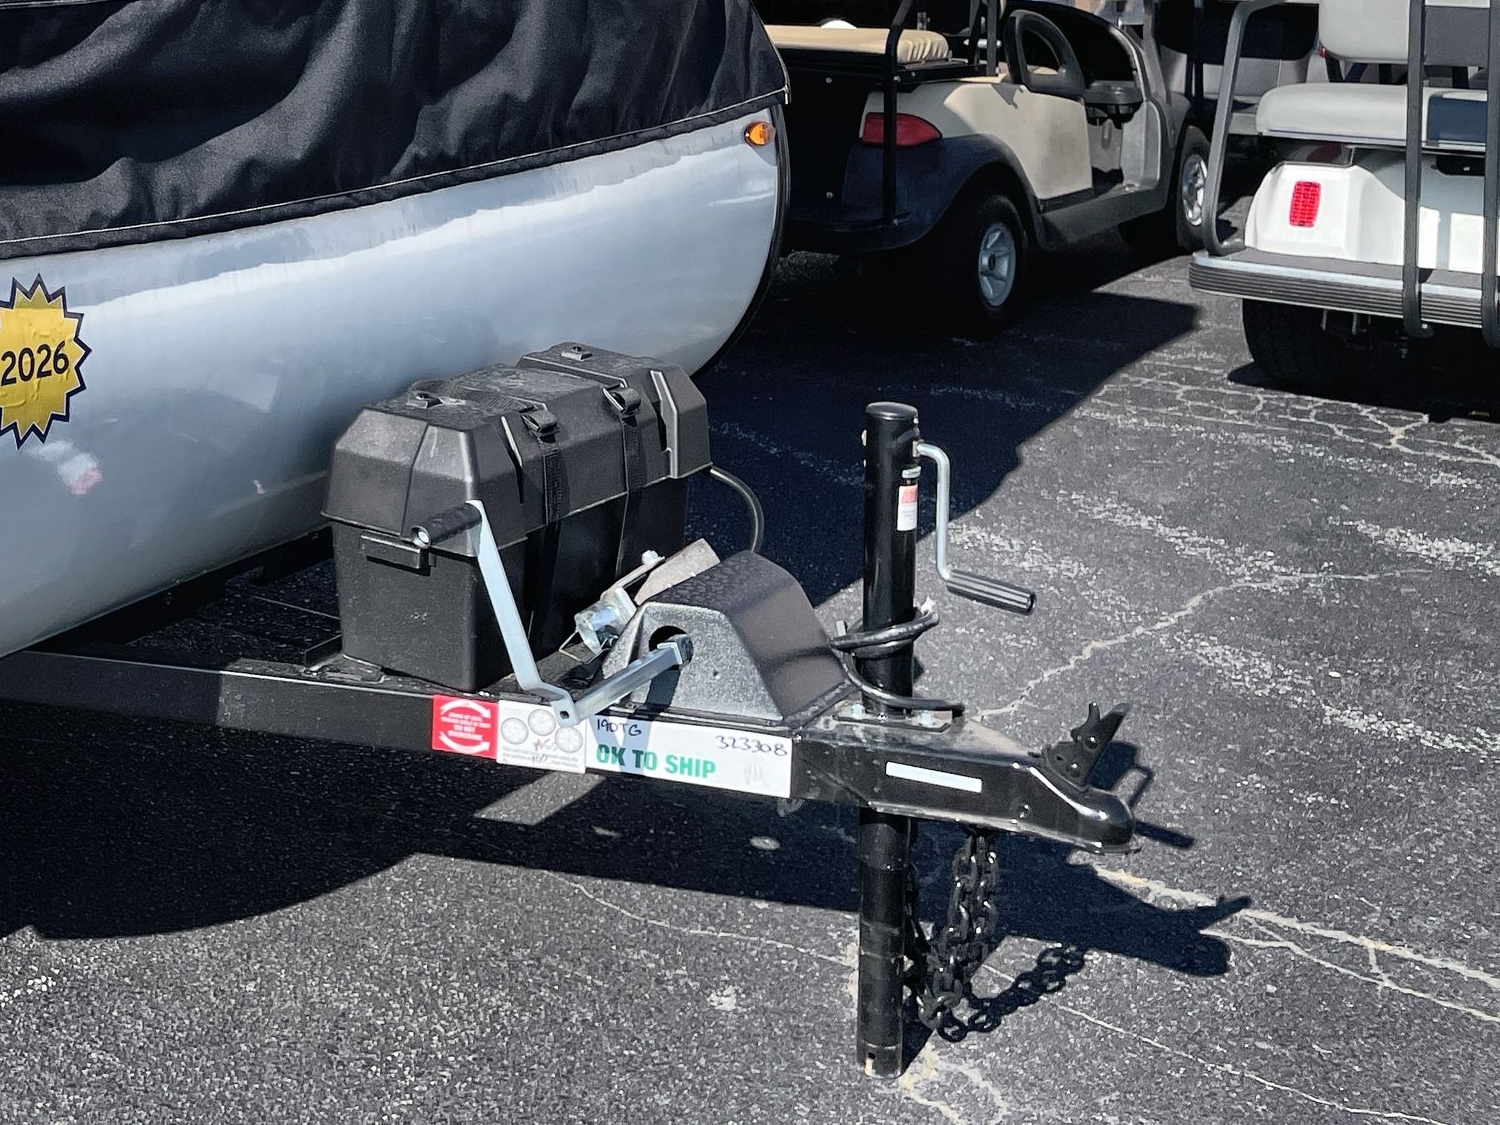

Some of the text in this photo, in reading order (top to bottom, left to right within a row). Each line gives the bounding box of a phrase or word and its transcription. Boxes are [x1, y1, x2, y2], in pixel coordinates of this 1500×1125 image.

[1, 340, 70, 387] 2026
[596, 743, 626, 767] OK
[632, 748, 659, 771] TO
[665, 753, 717, 778] SHIP
[715, 735, 788, 757] 323308
